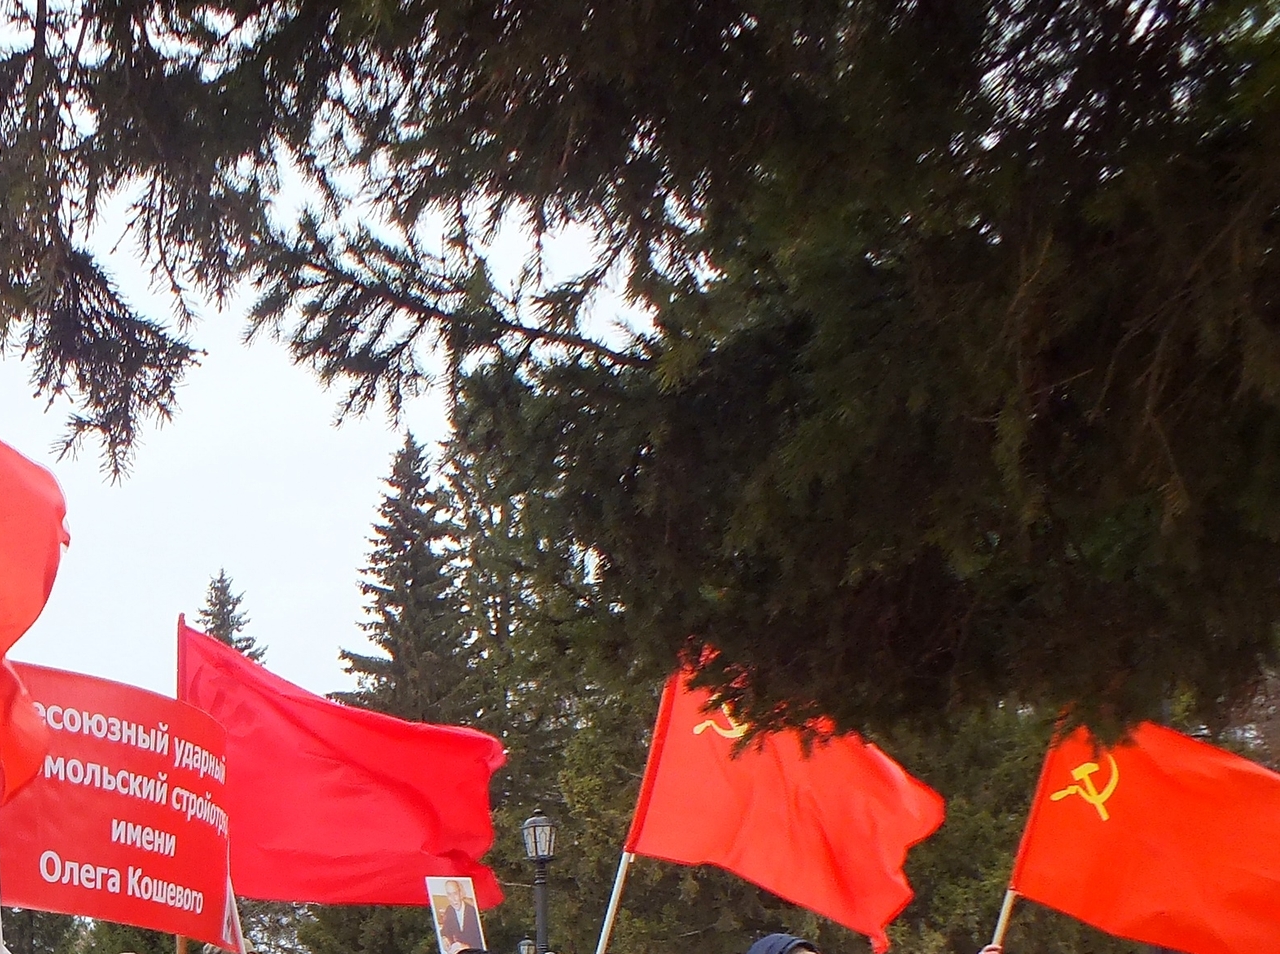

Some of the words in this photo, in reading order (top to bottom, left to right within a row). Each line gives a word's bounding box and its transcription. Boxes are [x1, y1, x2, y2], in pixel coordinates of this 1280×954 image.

[44, 755, 169, 806] мольский
[174, 737, 226, 785] ударный
[111, 818, 176, 857] имени
[39, 850, 120, 893] Олега
[127, 866, 203, 914] Кошевого
